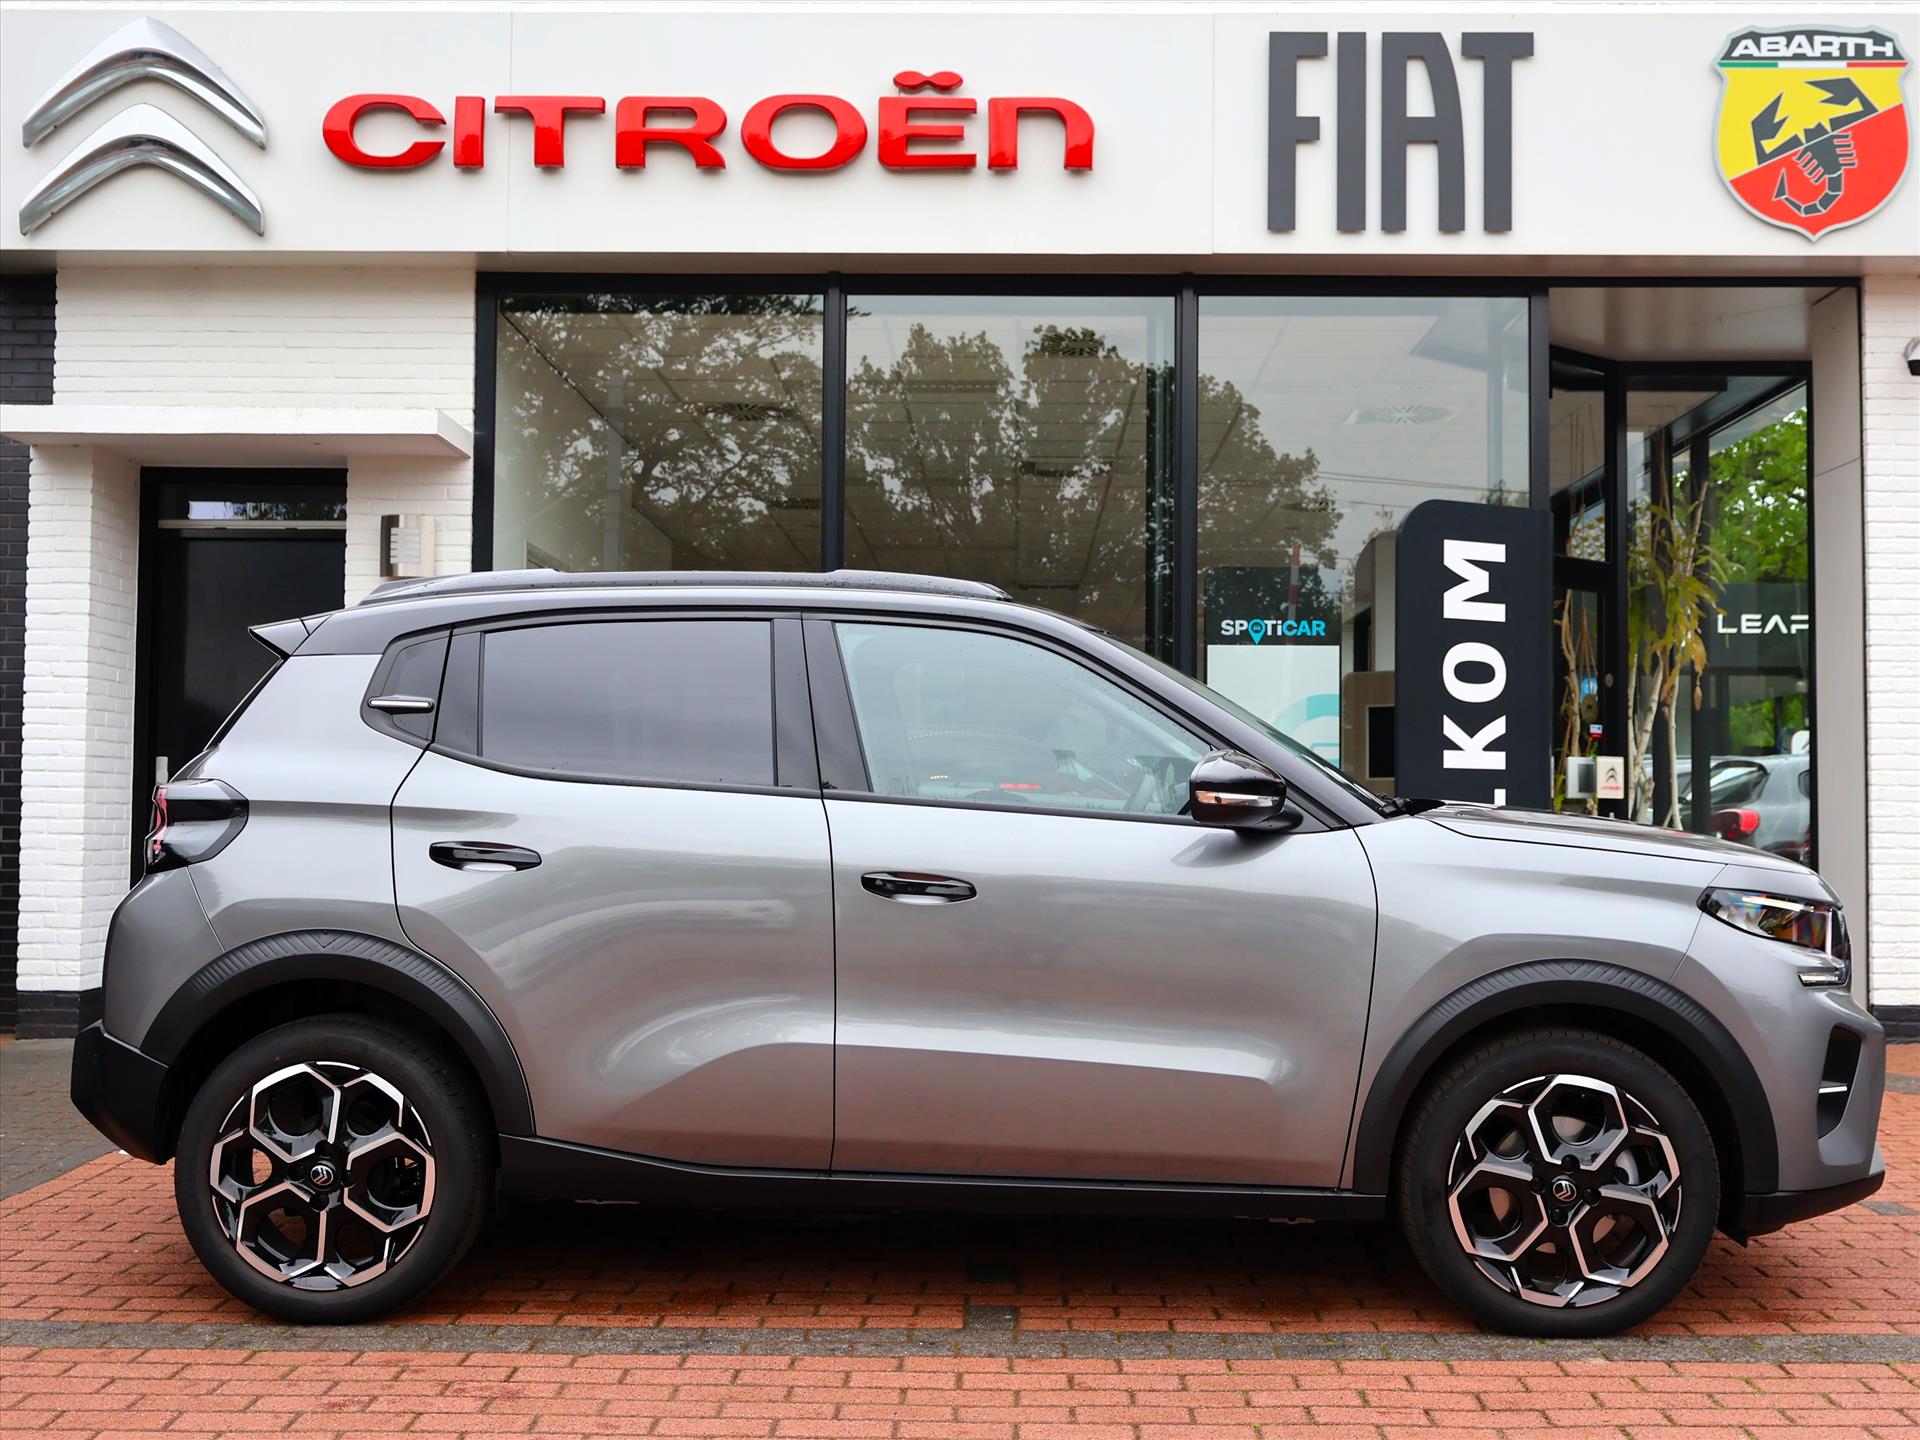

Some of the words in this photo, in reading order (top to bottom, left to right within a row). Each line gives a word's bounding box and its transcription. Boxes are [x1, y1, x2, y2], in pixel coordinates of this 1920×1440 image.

[1268, 31, 1534, 233] FIAT
[1731, 35, 1894, 57] ABARTH
[1442, 539, 1507, 806] KOM
